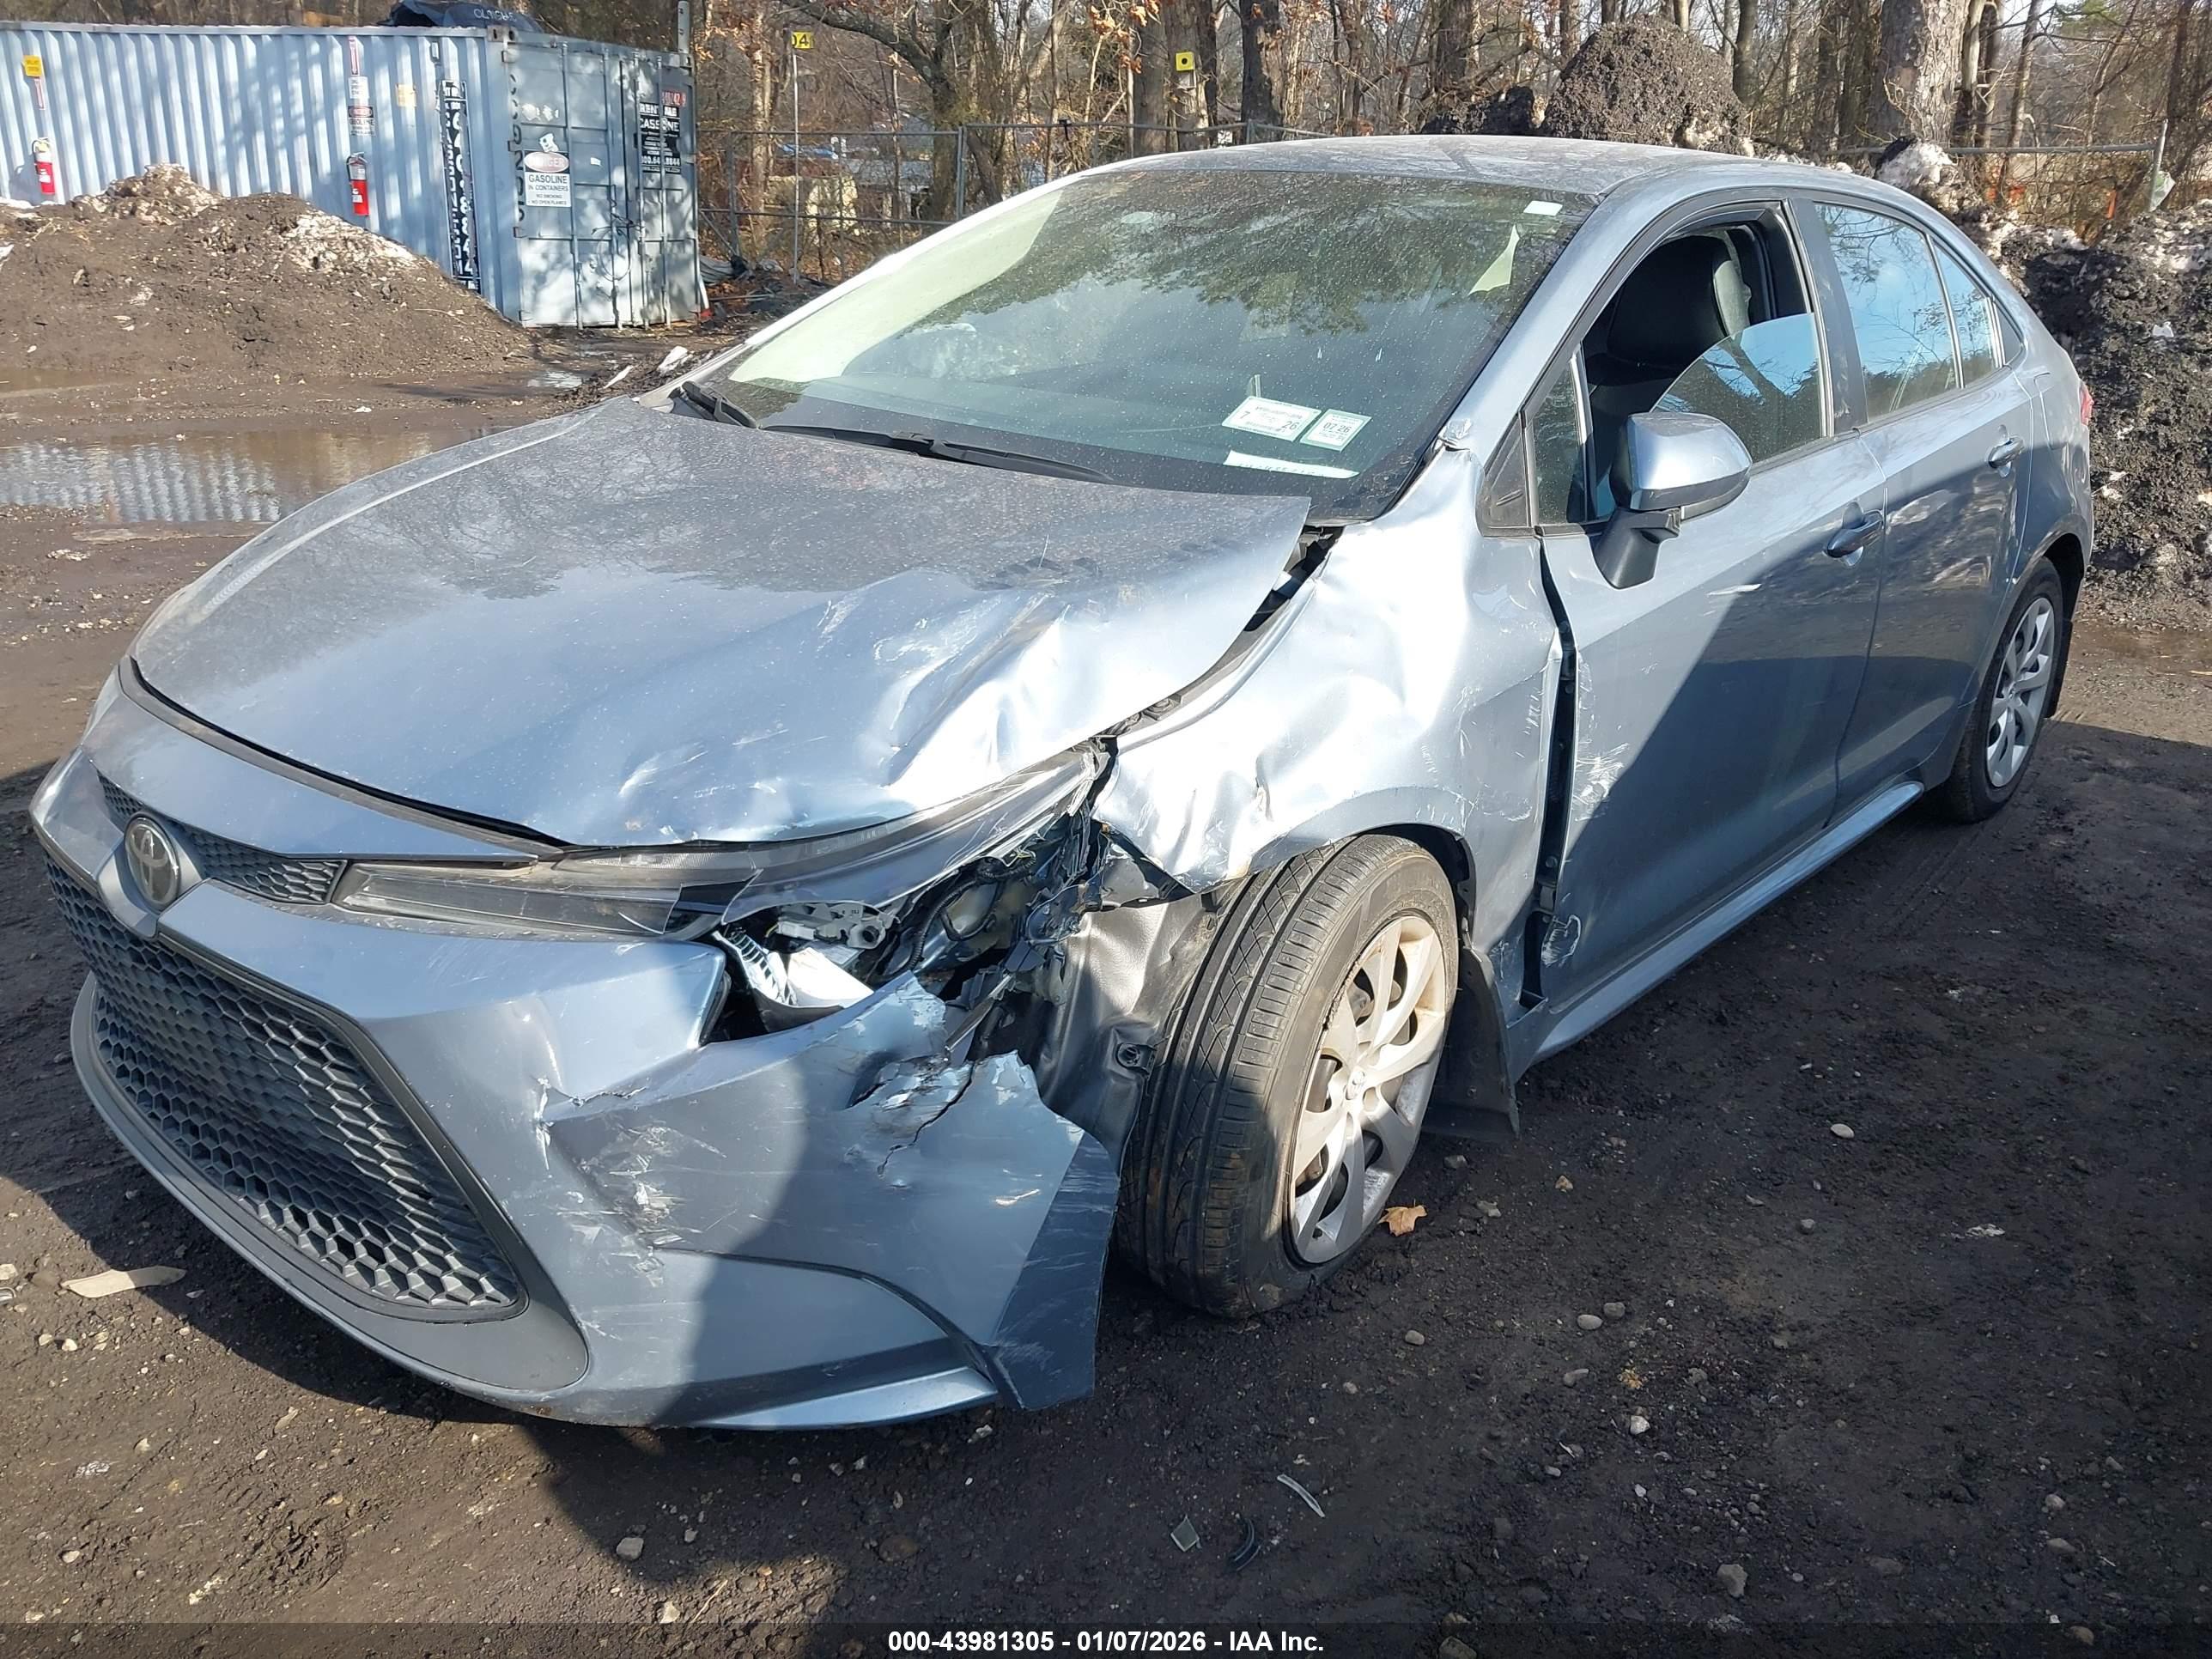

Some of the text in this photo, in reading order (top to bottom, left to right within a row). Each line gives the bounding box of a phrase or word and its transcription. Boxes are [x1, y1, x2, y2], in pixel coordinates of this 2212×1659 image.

[528, 174, 568, 184] GASOLINE
[1239, 410, 1251, 419] 7
[1281, 420, 1300, 431] 26
[1337, 424, 1352, 434] 26
